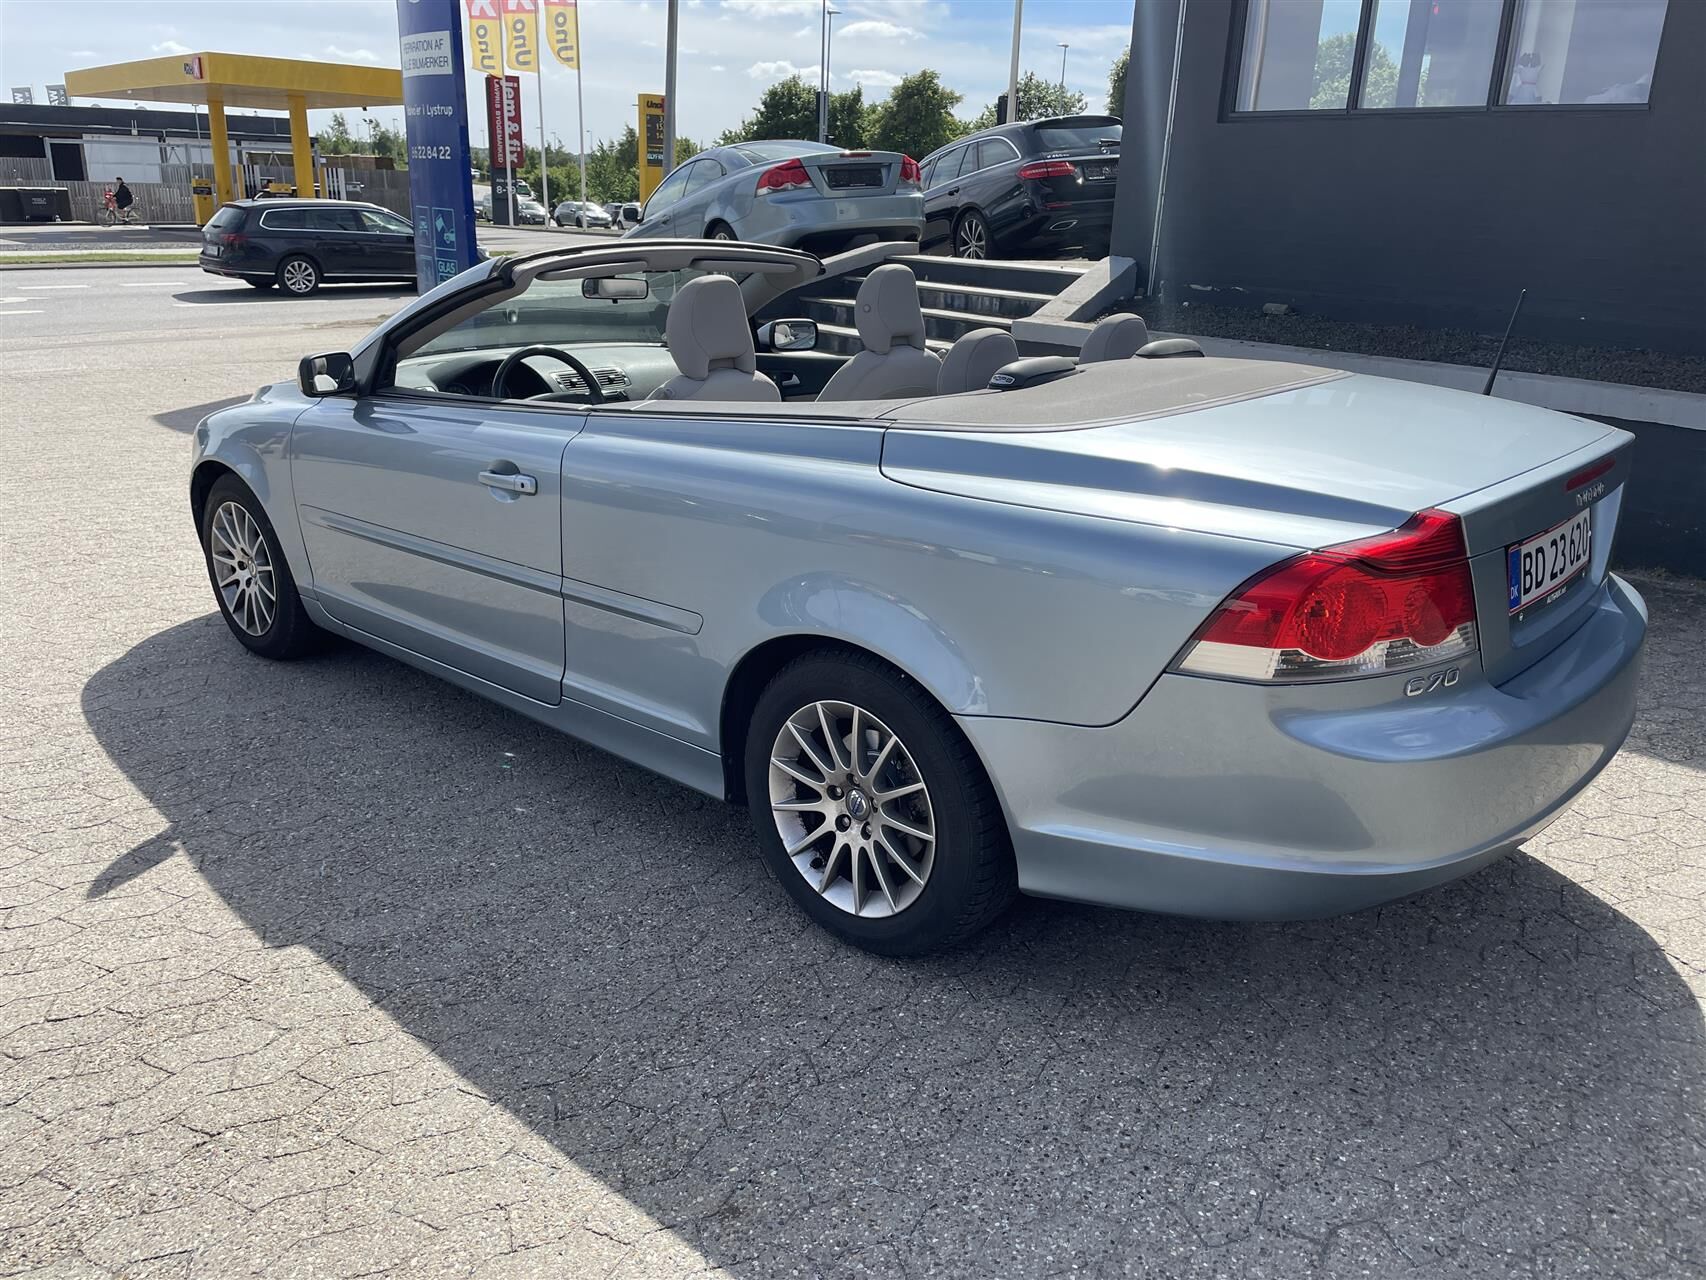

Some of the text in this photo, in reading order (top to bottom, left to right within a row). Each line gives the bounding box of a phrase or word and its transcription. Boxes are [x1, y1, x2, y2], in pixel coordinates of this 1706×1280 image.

[553, 0, 574, 62] Uno
[426, 104, 453, 118] Lystrup
[437, 261, 456, 274] GLAS
[1522, 516, 1590, 597] BD 23 620
[1510, 584, 1520, 601] DK
[1404, 666, 1460, 697] C70
